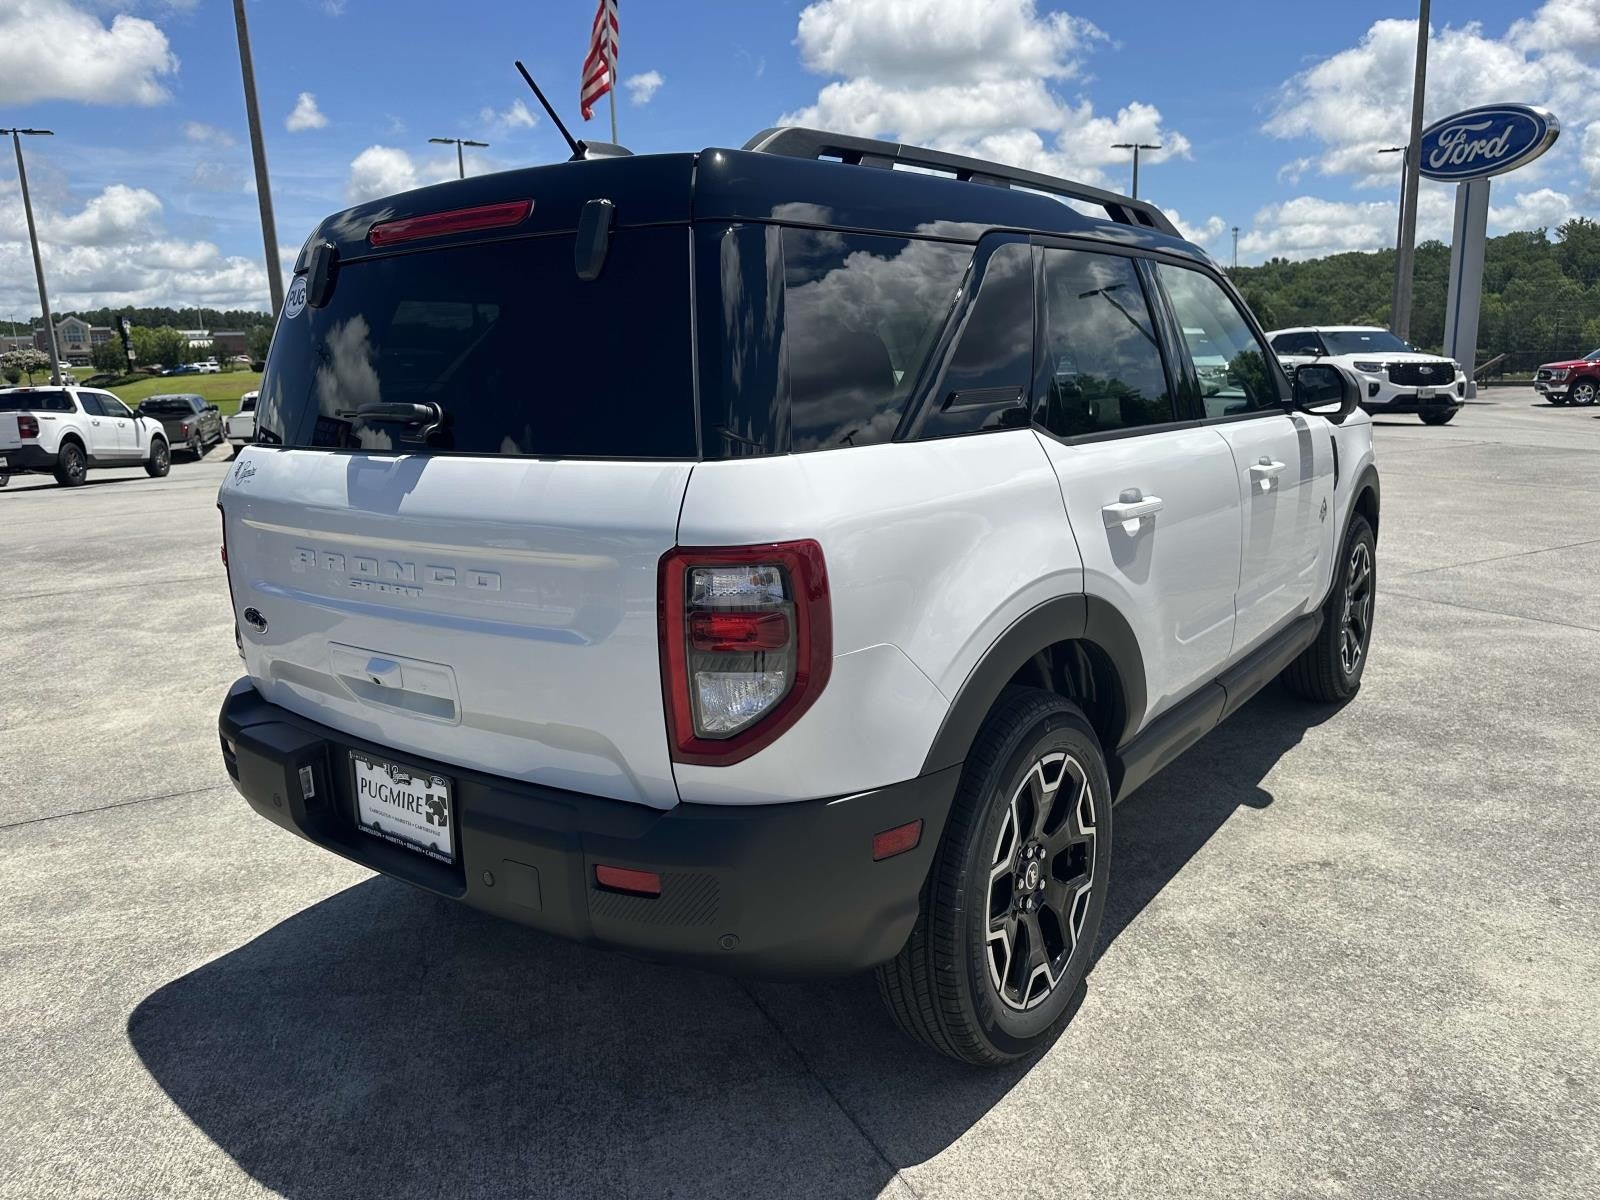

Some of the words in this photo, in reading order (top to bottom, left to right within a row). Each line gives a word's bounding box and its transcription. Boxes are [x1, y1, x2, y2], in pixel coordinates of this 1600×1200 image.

[1429, 120, 1514, 168] Ford
[288, 288, 305, 307] PUG
[294, 546, 502, 592] BRONCO
[349, 577, 424, 598] SPORT
[360, 777, 423, 815] PUGMIRE
